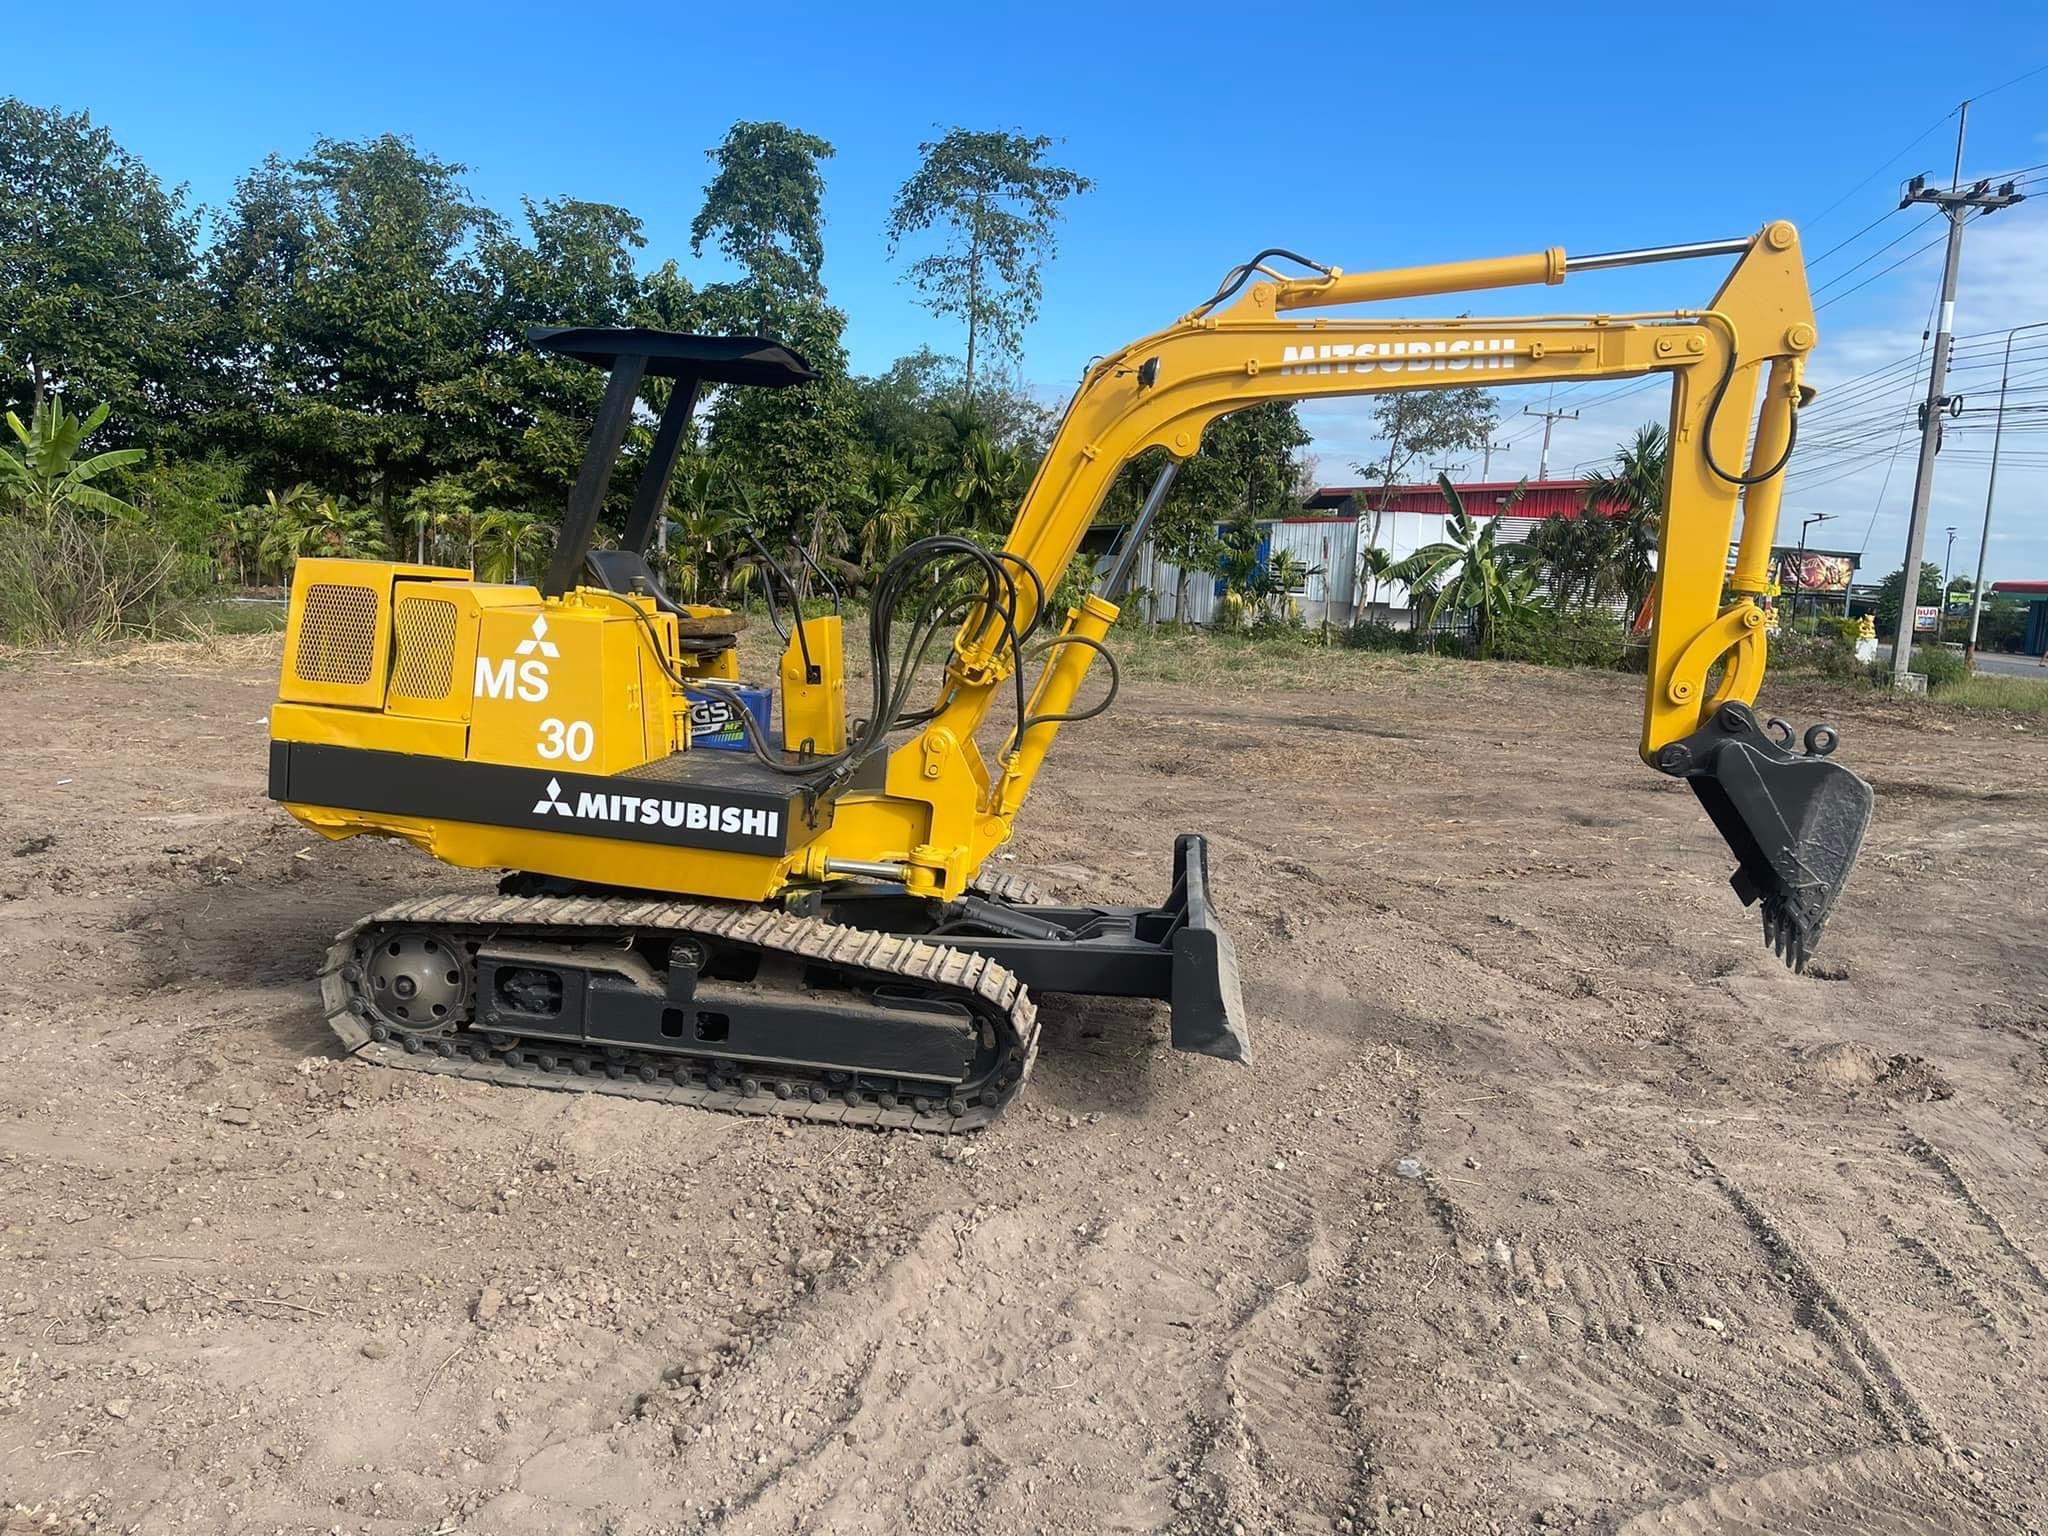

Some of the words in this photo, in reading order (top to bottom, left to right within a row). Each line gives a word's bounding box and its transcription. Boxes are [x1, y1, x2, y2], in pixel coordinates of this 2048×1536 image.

[1281, 339, 1515, 375] MITSUBISHI
[475, 657, 549, 701] MS
[692, 702, 729, 723] GS
[538, 719, 594, 762] 30
[576, 792, 779, 837] MITSUBISHI
